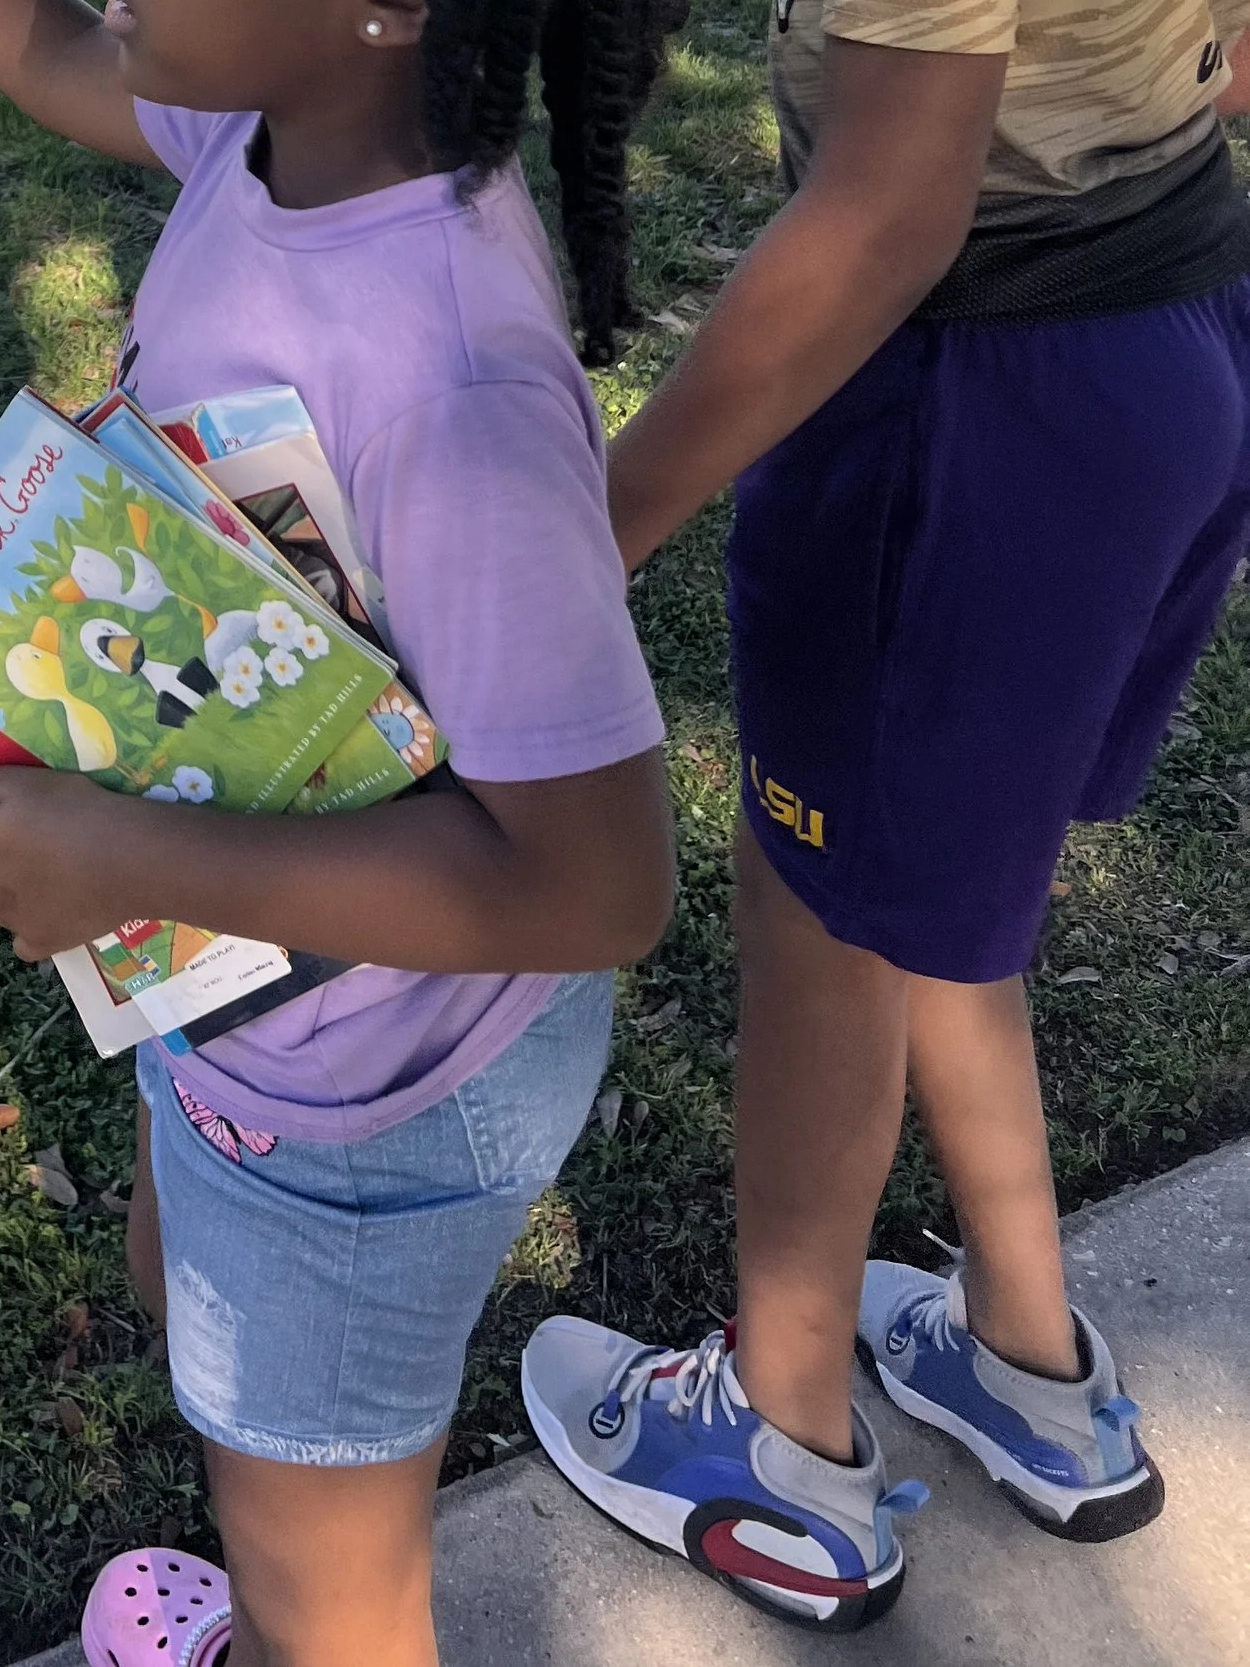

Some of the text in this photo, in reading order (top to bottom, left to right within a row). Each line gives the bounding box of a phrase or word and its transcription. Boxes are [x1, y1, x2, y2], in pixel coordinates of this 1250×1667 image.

[258, 673, 363, 802] ILLUSTRATED BY TAD HILLS
[315, 768, 390, 815] BY TAD HILLS
[189, 958, 208, 971] MADE
[208, 953, 218, 962] TO
